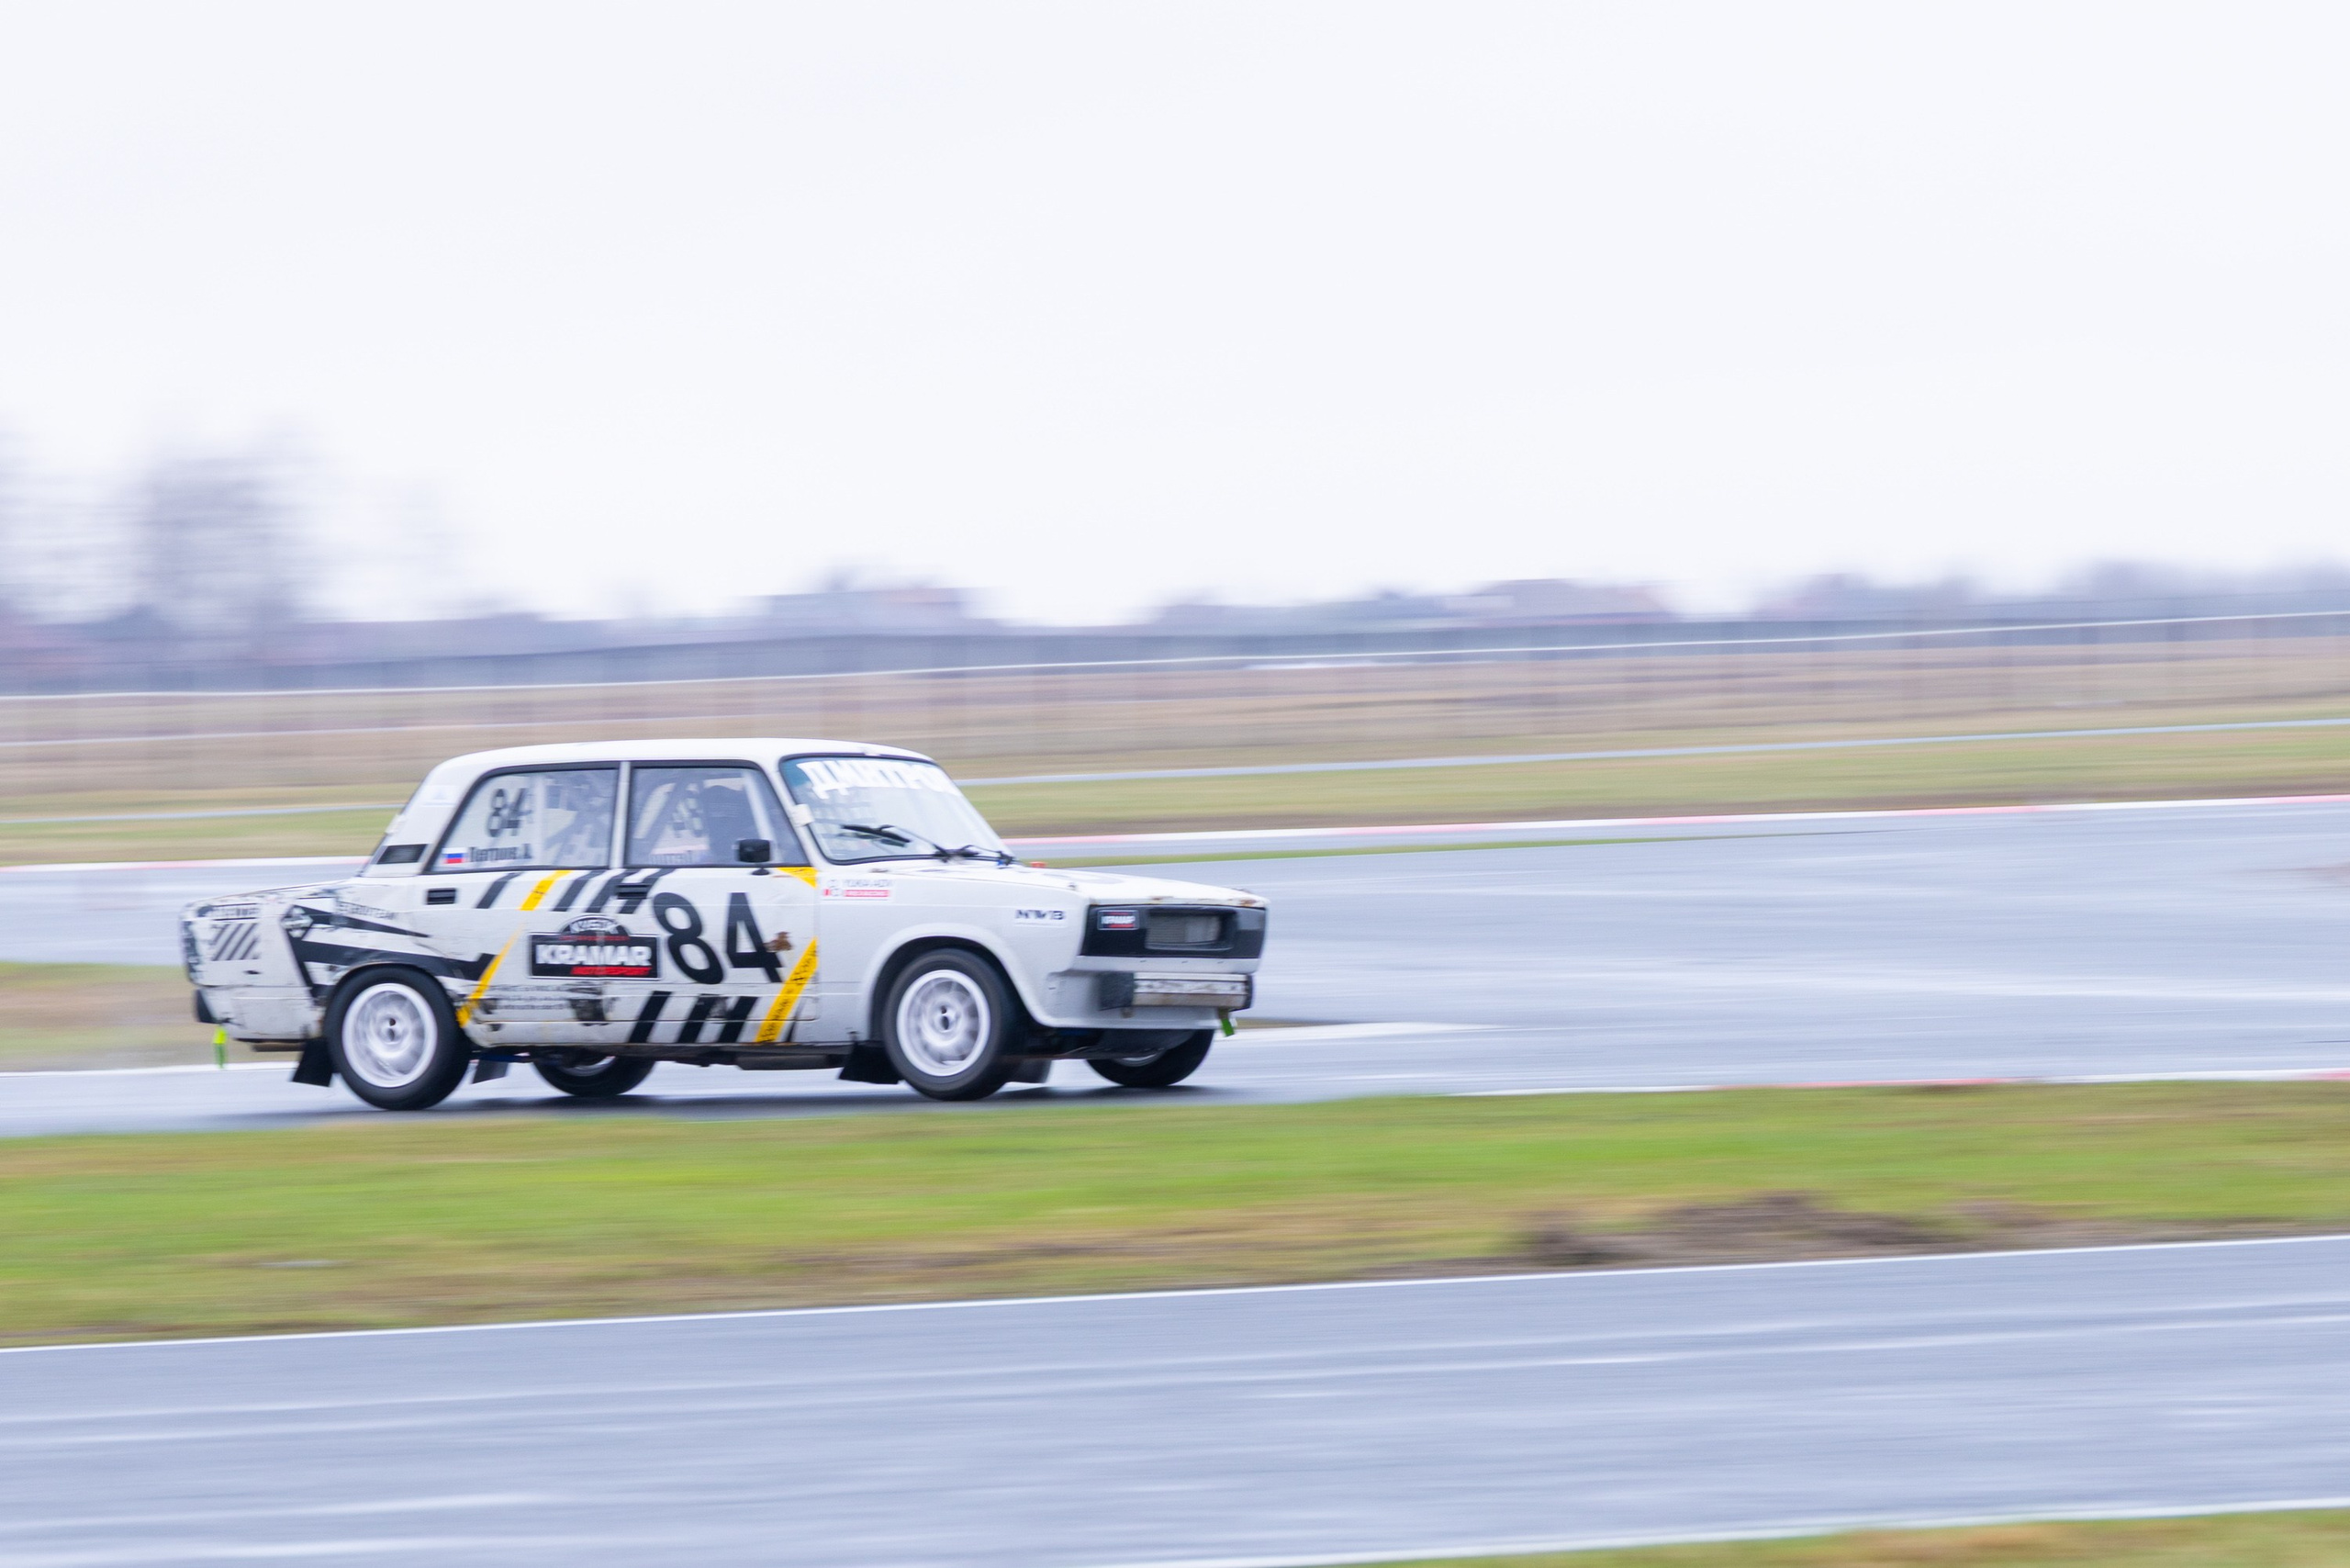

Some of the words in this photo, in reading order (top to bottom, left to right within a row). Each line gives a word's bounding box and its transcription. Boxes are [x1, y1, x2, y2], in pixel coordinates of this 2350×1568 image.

[487, 788, 527, 834] 84
[535, 944, 652, 966] KRAMAR
[653, 891, 783, 985] 84
